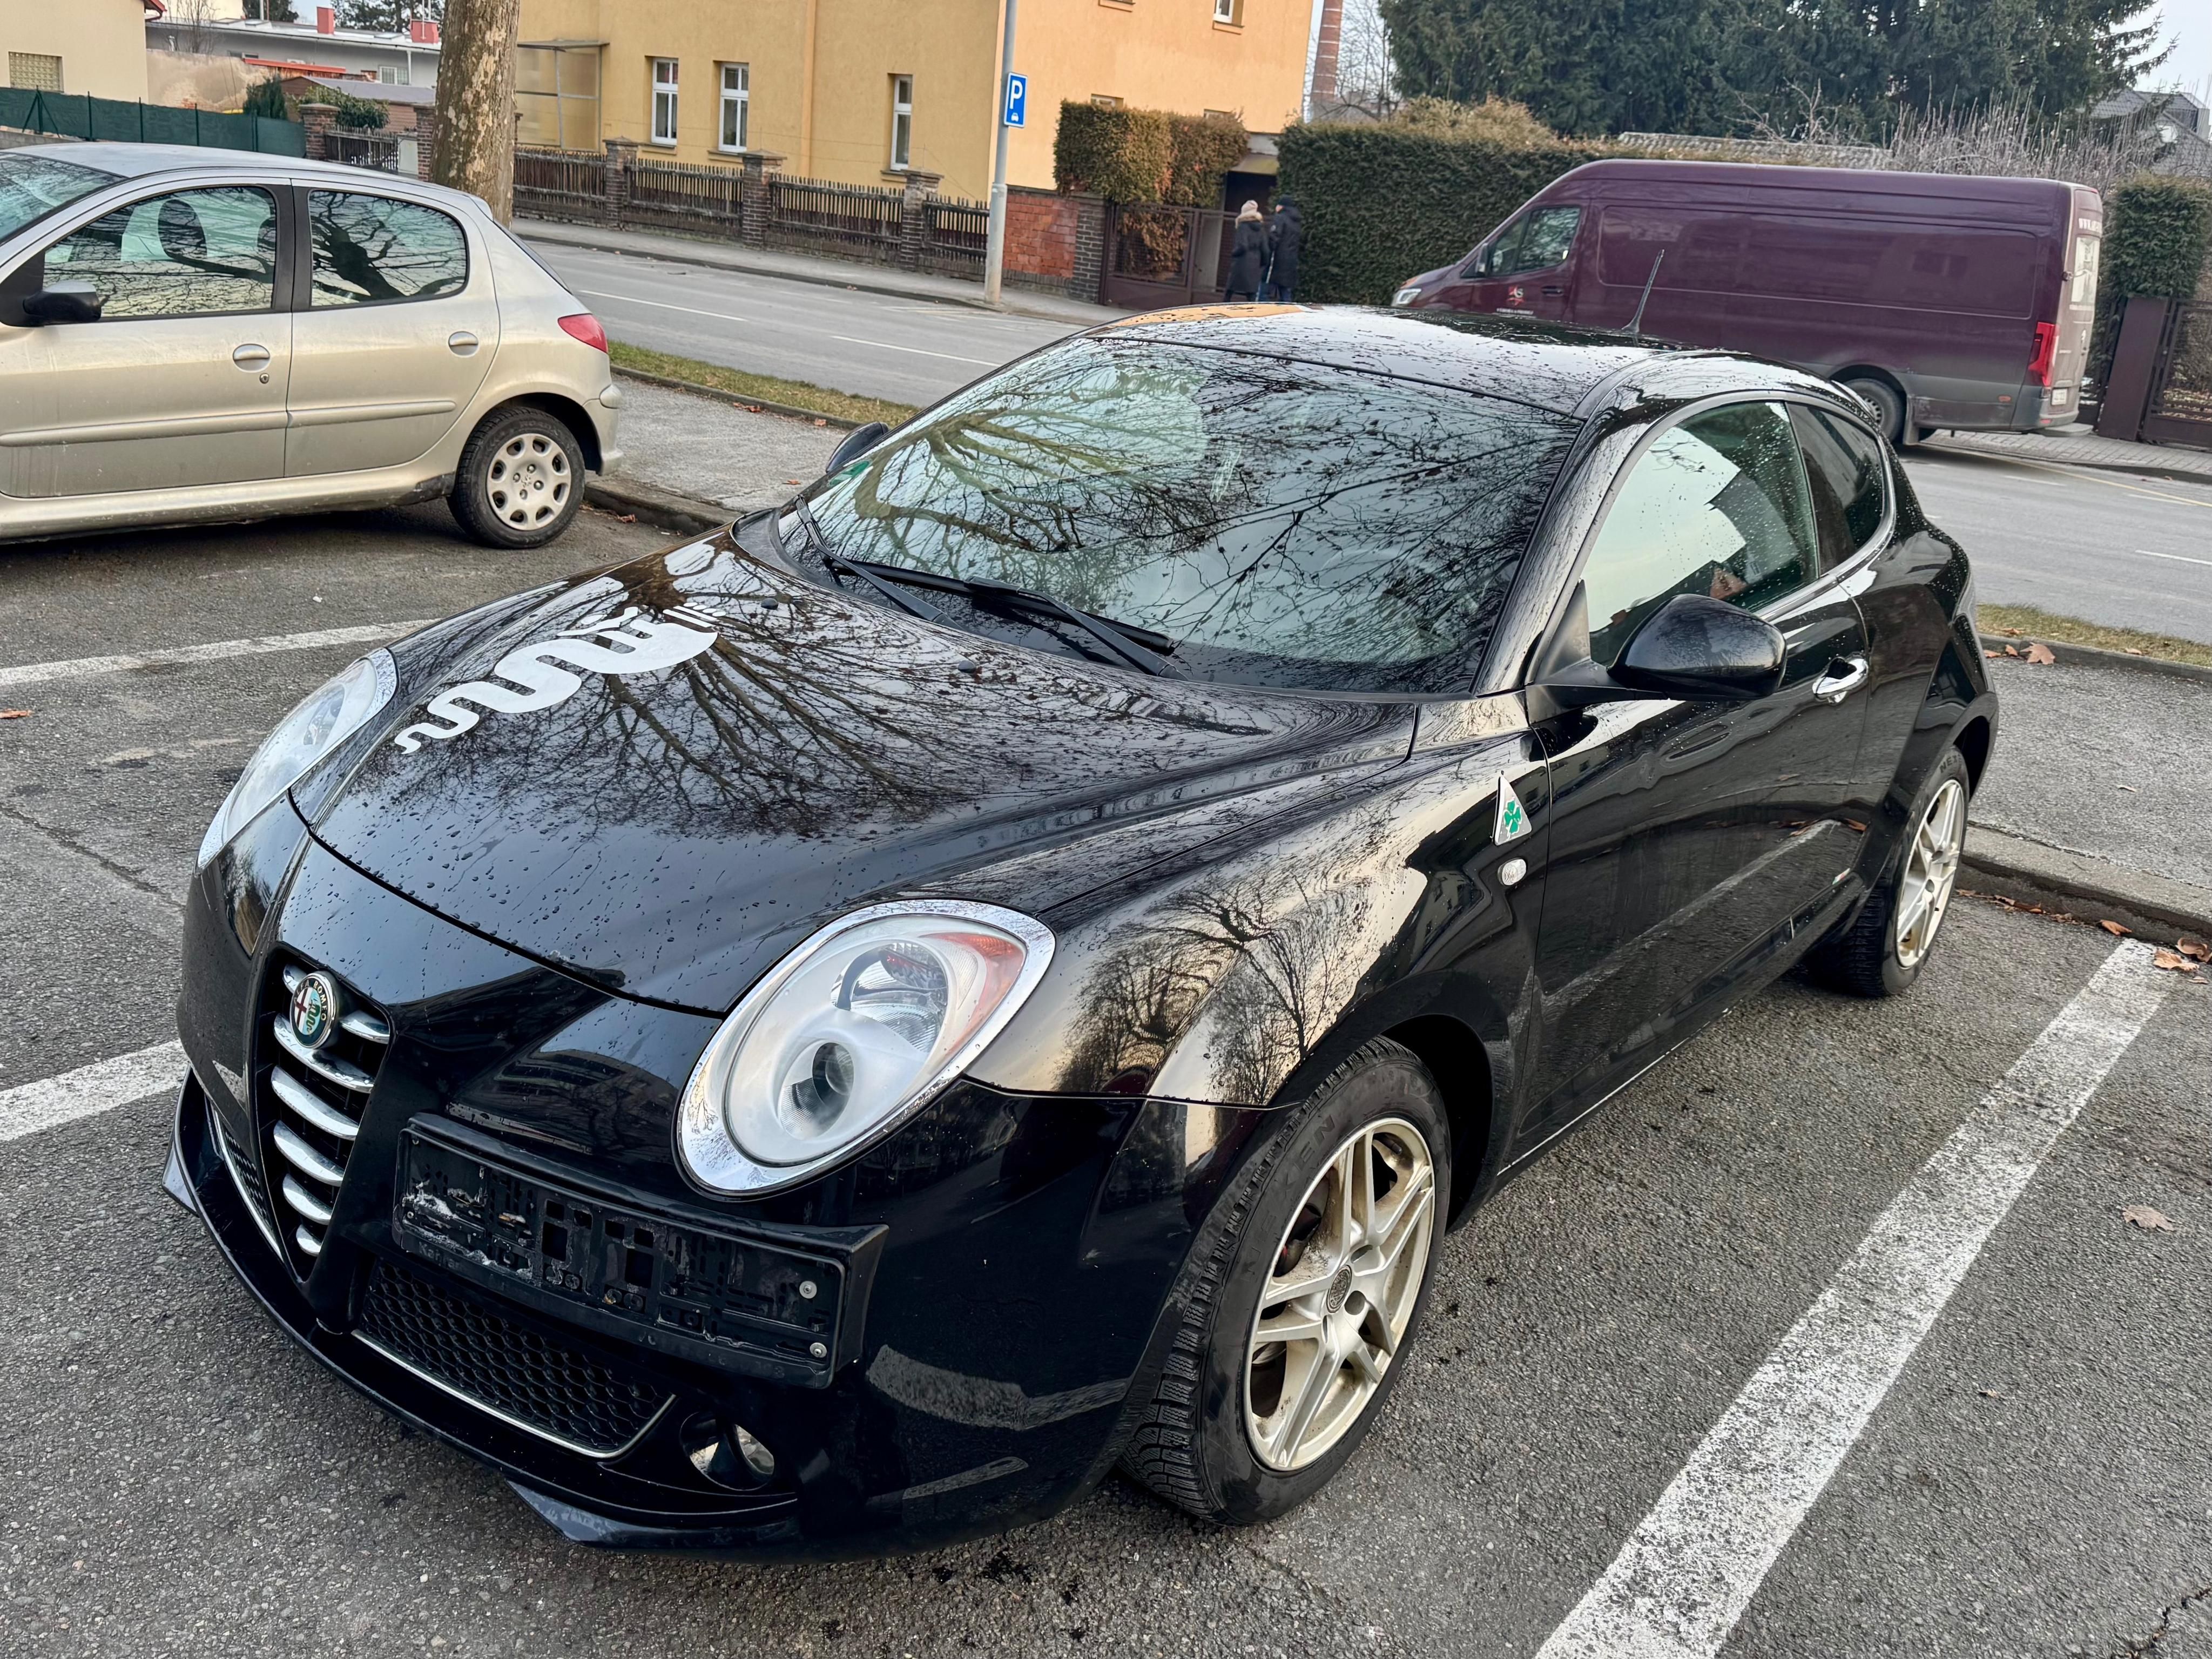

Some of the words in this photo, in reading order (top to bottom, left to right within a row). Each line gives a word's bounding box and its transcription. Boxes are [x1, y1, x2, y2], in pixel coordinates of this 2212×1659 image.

[1009, 79, 1023, 109] P
[293, 980, 309, 1004] ALFA
[313, 981, 328, 1021] ROMEO
